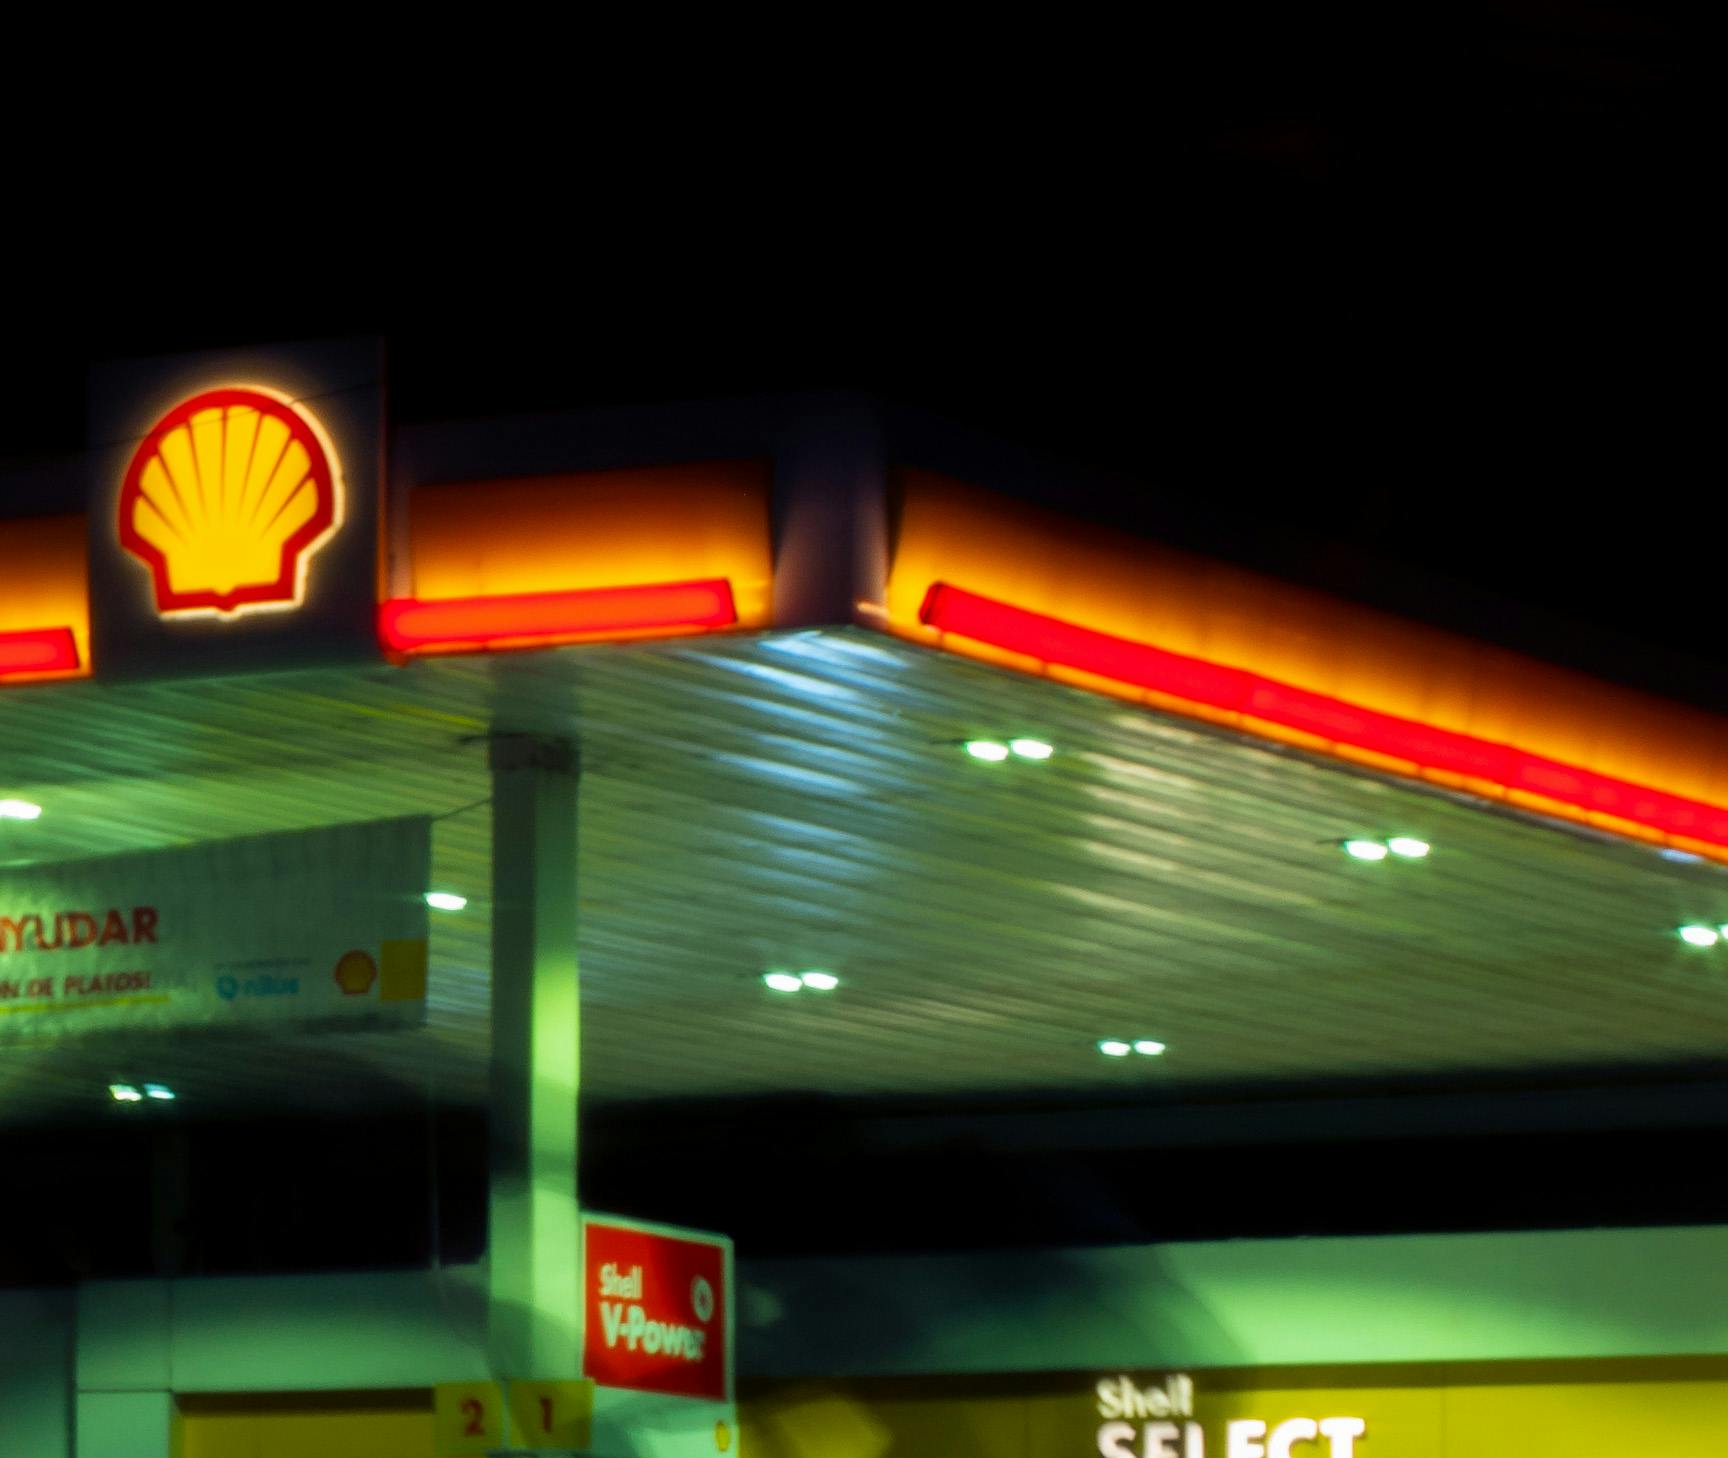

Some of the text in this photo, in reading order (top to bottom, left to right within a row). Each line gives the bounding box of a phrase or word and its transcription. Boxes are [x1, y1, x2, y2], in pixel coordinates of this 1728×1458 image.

[28, 976, 54, 999] DE
[599, 1262, 643, 1299] Shell
[600, 1301, 706, 1362] V-Power
[1097, 1373, 1194, 1419] Shell
[462, 1398, 553, 1436] 2 1
